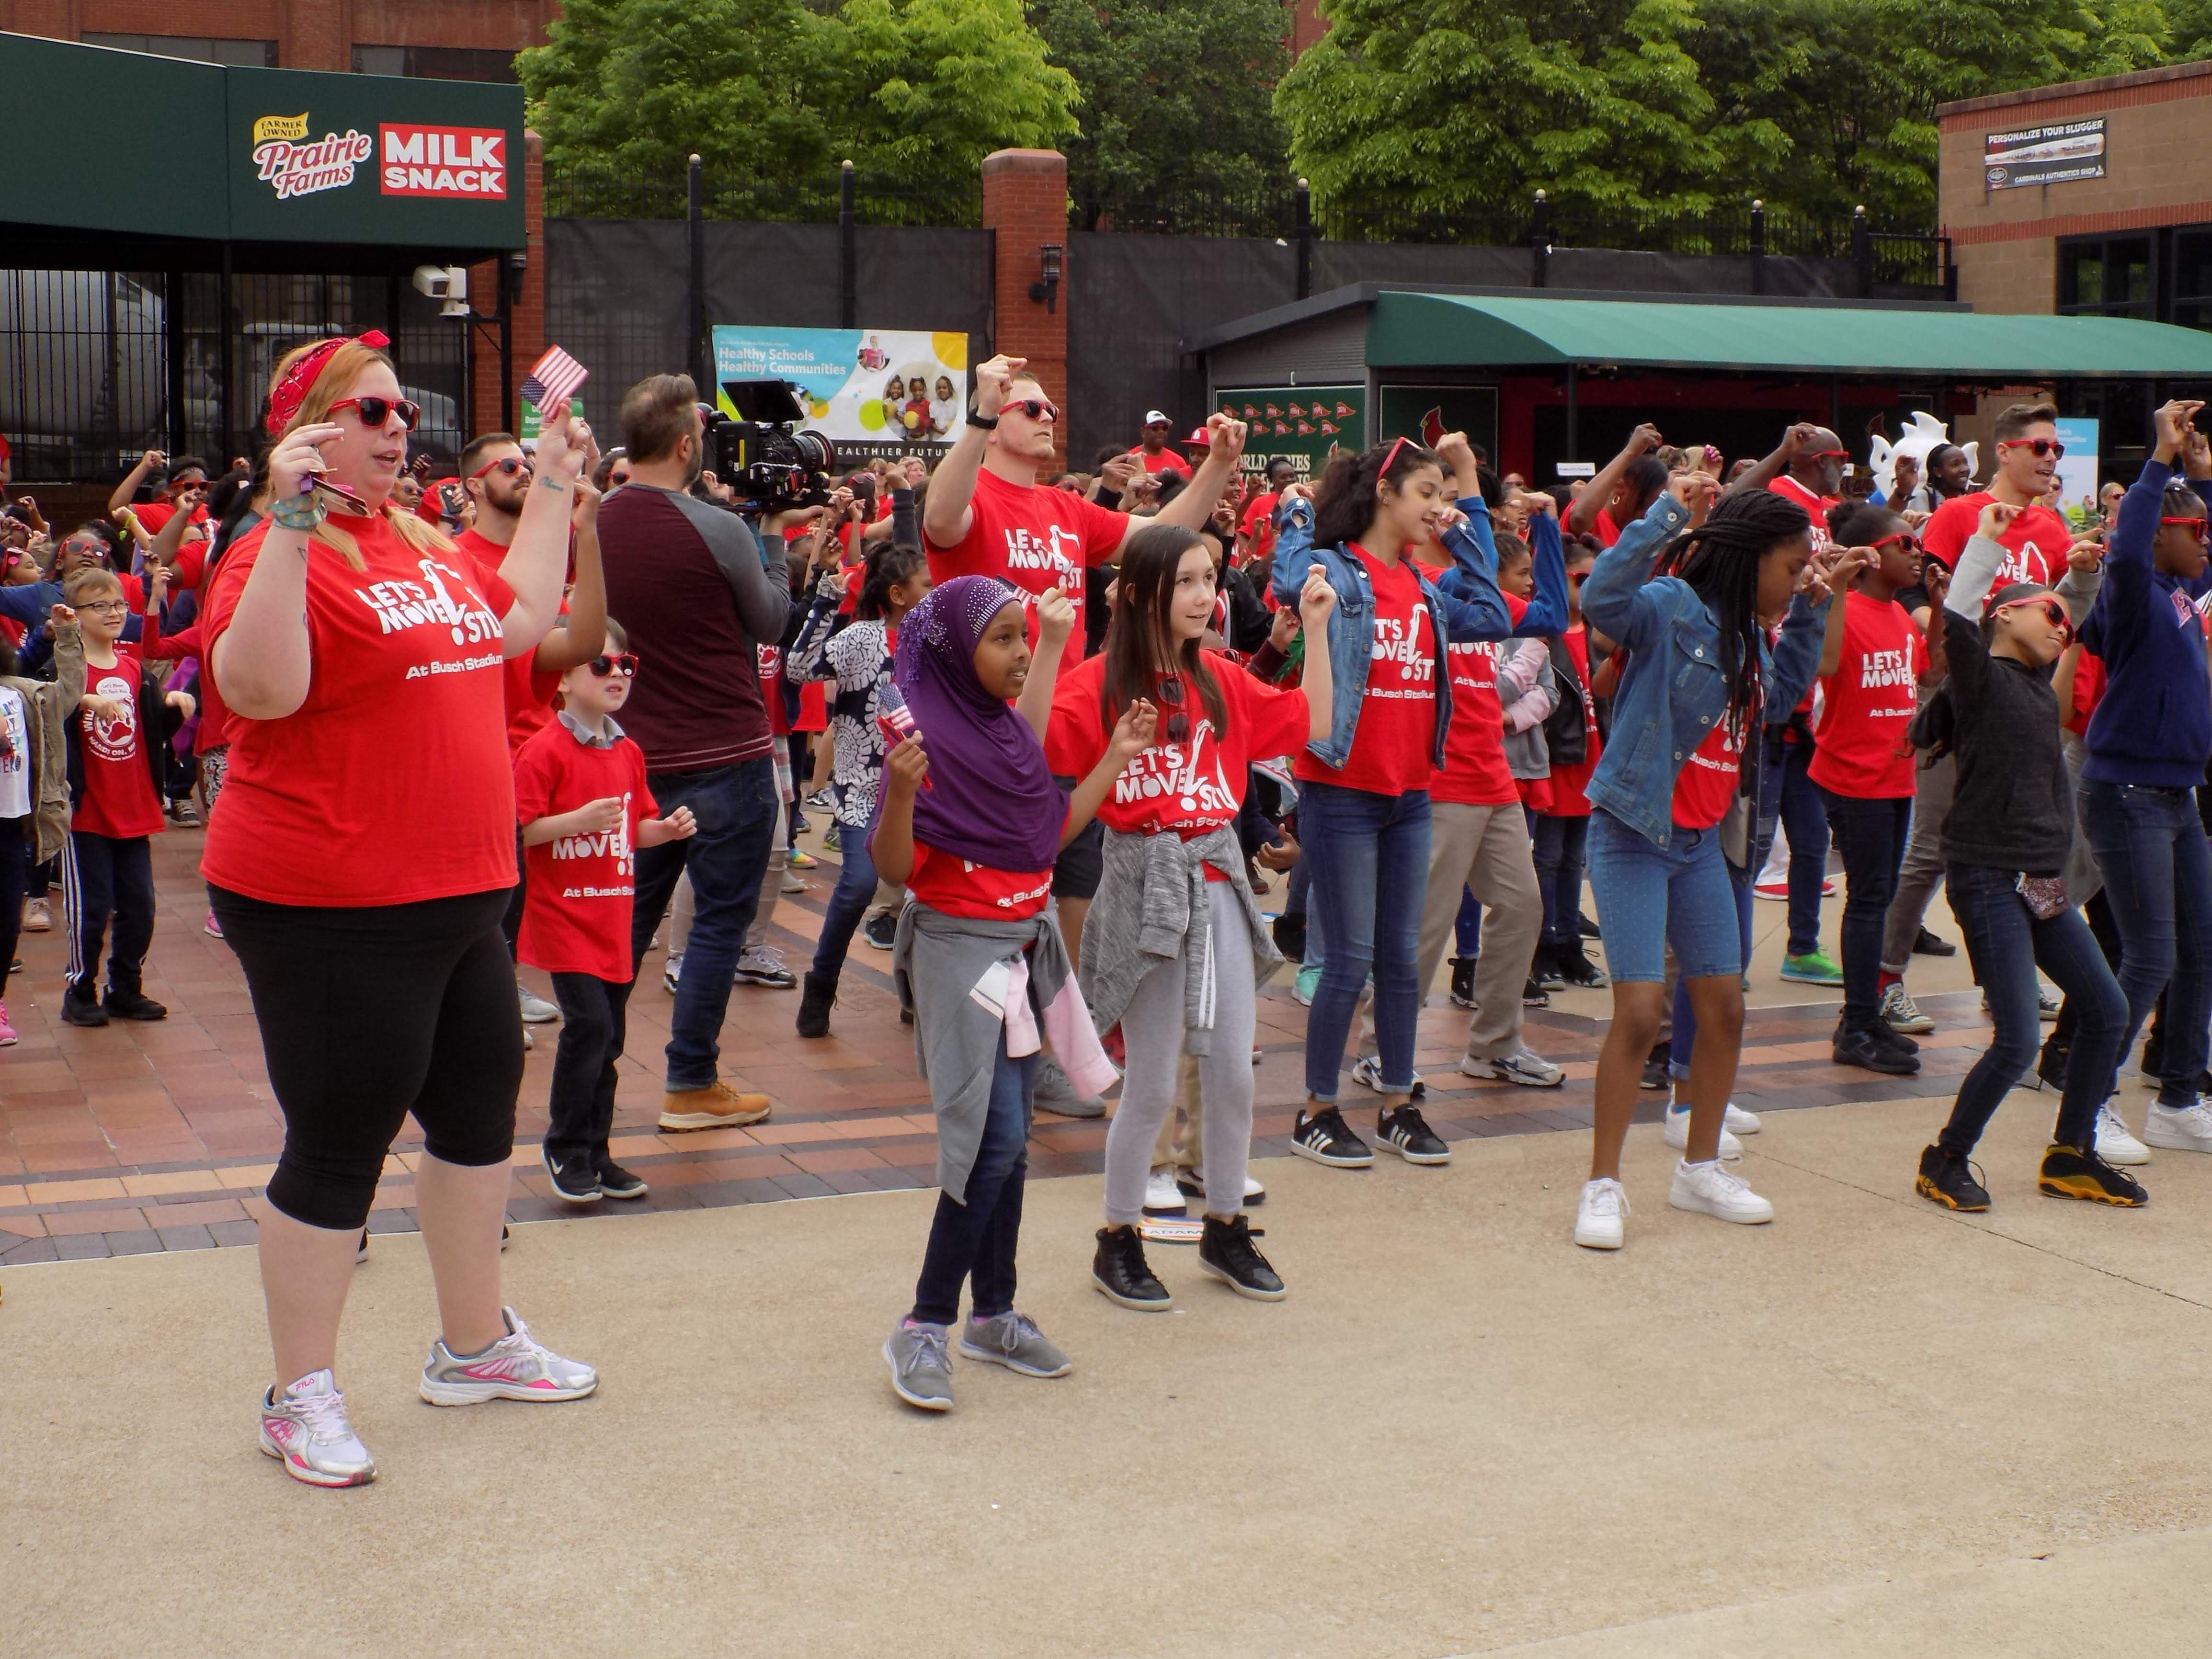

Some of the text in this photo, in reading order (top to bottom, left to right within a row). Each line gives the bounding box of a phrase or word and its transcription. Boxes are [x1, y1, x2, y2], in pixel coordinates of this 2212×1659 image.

[261, 120, 302, 129] FARMER
[1988, 120, 2104, 144] PERSONALIZE YOUR SLUGGER
[263, 129, 301, 137] OWNED
[256, 132, 370, 176] Prairie
[385, 131, 504, 168] MILK
[276, 166, 353, 195] Farms
[385, 167, 504, 193] SNACK
[2014, 173, 2045, 183] CARDINALS
[2080, 167, 2096, 175] SHOP
[719, 348, 814, 362] Healthy Schools
[719, 361, 846, 375] Healthy Communities
[837, 446, 902, 455] EALTHIER
[353, 581, 427, 609] LET'S
[1863, 649, 1903, 670] LET'S
[405, 666, 430, 680] At
[430, 660, 465, 674] Busch
[1454, 676, 1494, 689] At Busch
[1371, 688, 1402, 698] Busch
[562, 887, 582, 898] At
[582, 886, 621, 898] Busch
[296, 1378, 315, 1392] FILA
